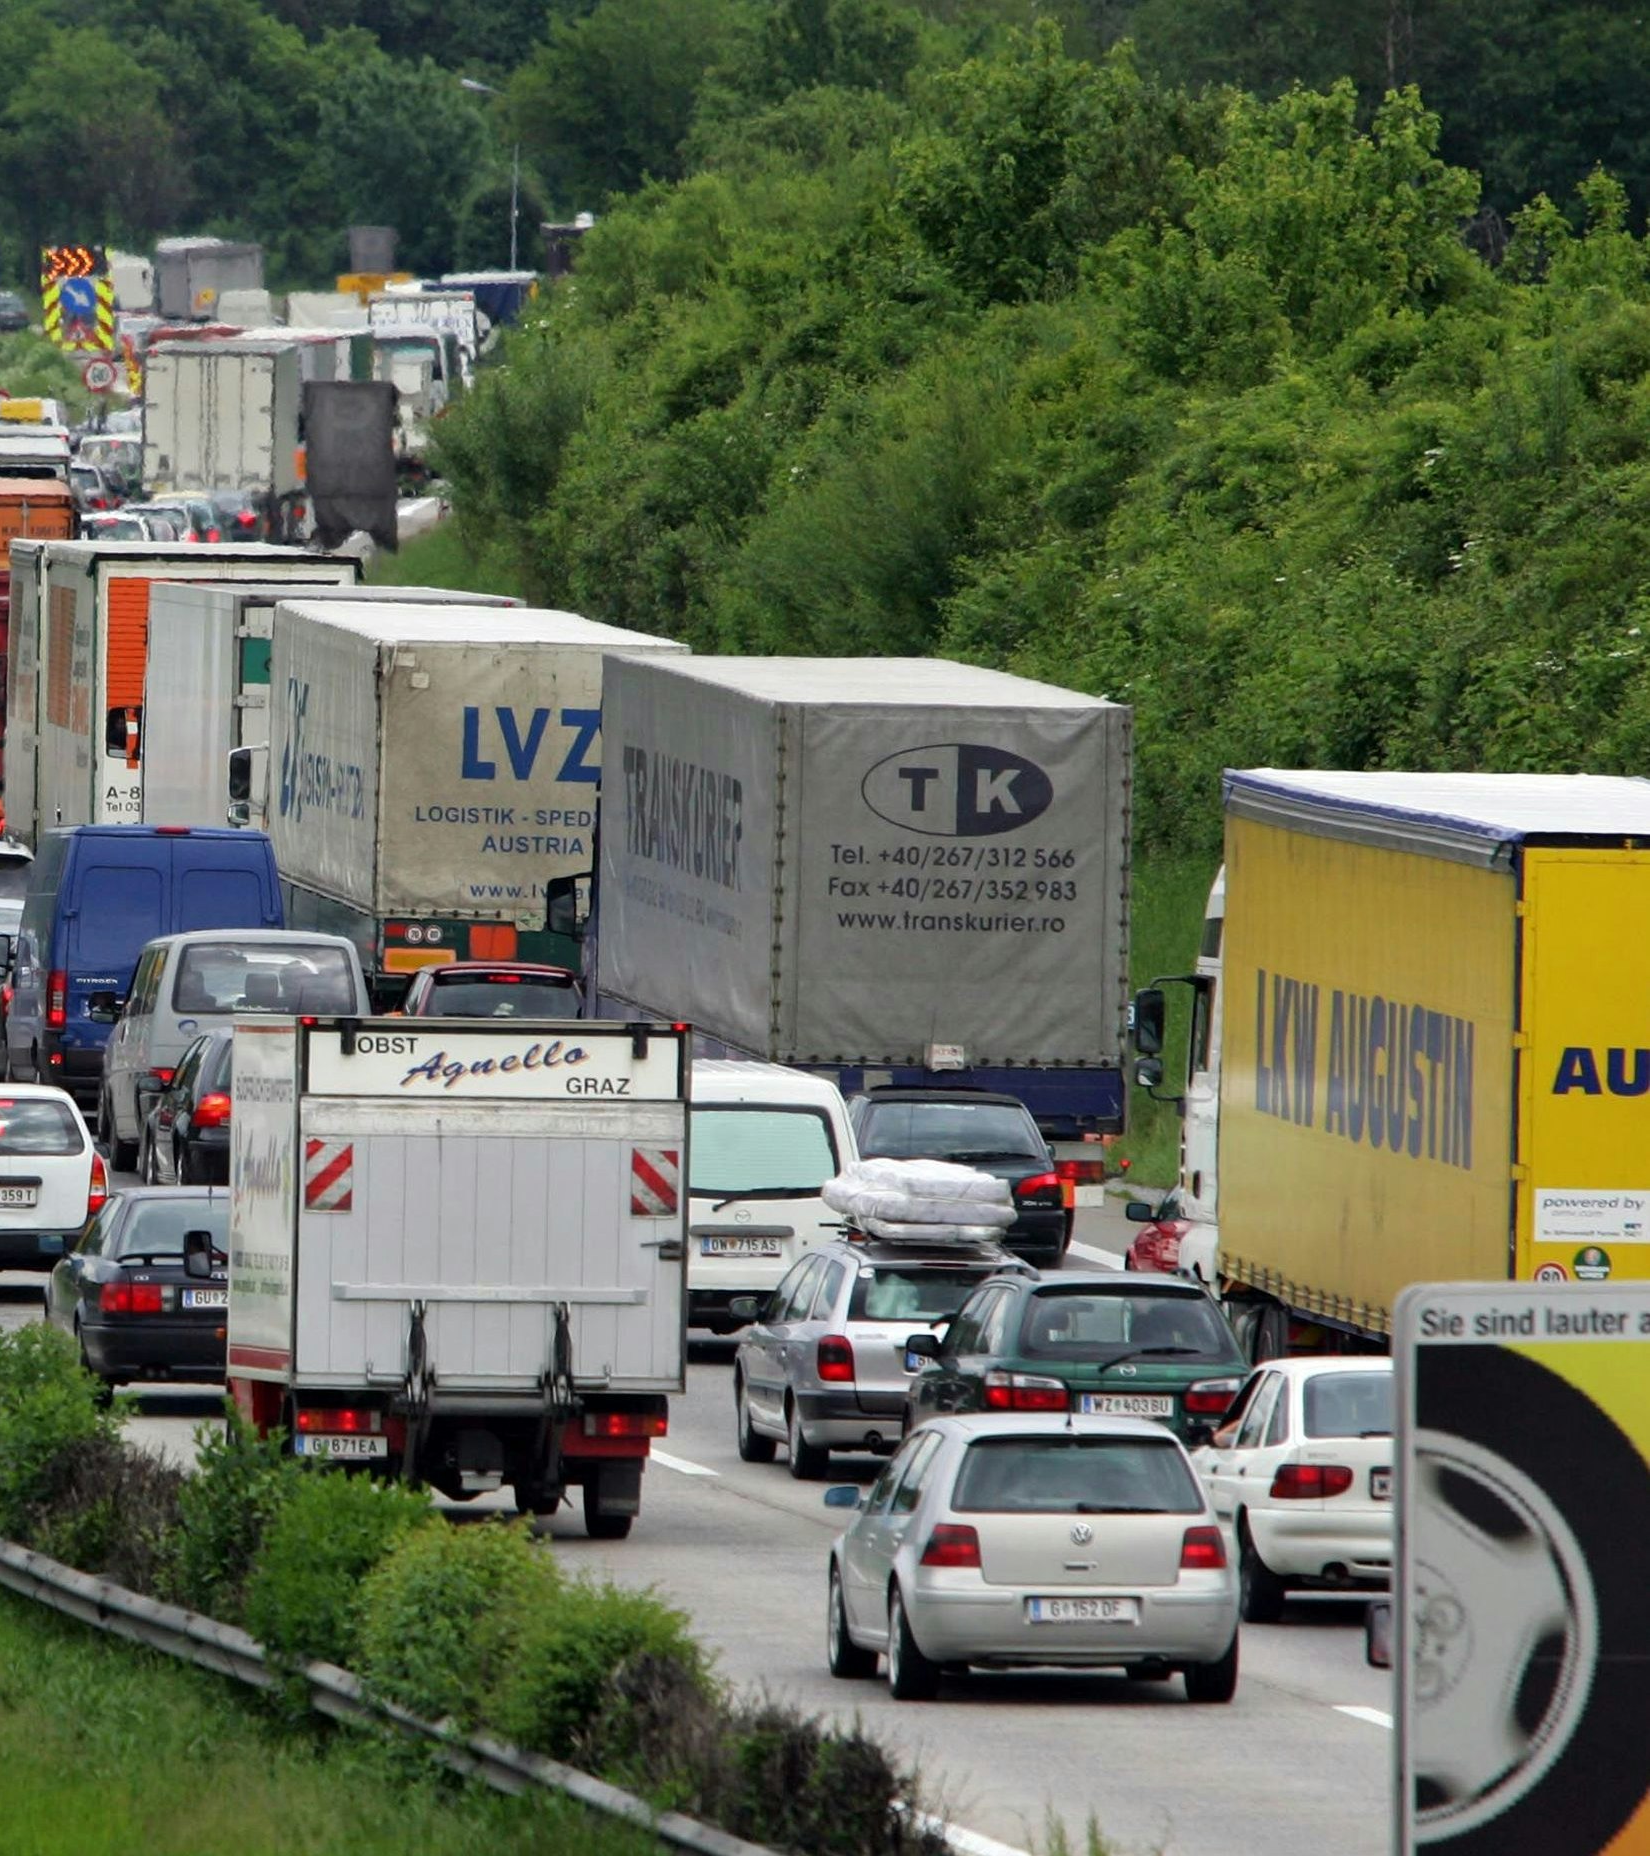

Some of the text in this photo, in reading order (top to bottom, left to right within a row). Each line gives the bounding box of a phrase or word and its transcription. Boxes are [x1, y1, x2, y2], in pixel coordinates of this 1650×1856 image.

[462, 707, 602, 783] LVZ
[106, 802, 122, 812] Tel
[415, 806, 515, 825] LOGISTIK
[623, 745, 743, 893] TRANSKURIER
[481, 835, 584, 855] AUSTRIA
[830, 844, 1076, 872] Tel. +40/267/312 566
[828, 876, 1077, 903] Fax +40/267/352 983
[837, 911, 1066, 934] www.transkurier.ro
[357, 1037, 418, 1054] OBST
[399, 1040, 592, 1088] Agnello
[1255, 967, 1475, 1172] LKW AUGUSTIN
[1551, 1047, 1650, 1097] AU
[565, 1077, 631, 1095] GRAZ
[1543, 1197, 1645, 1211] powered by
[1420, 1308, 1465, 1337] Sie
[1473, 1307, 1536, 1336] sind
[1545, 1307, 1629, 1335] lauter
[1050, 1600, 1061, 1617] G
